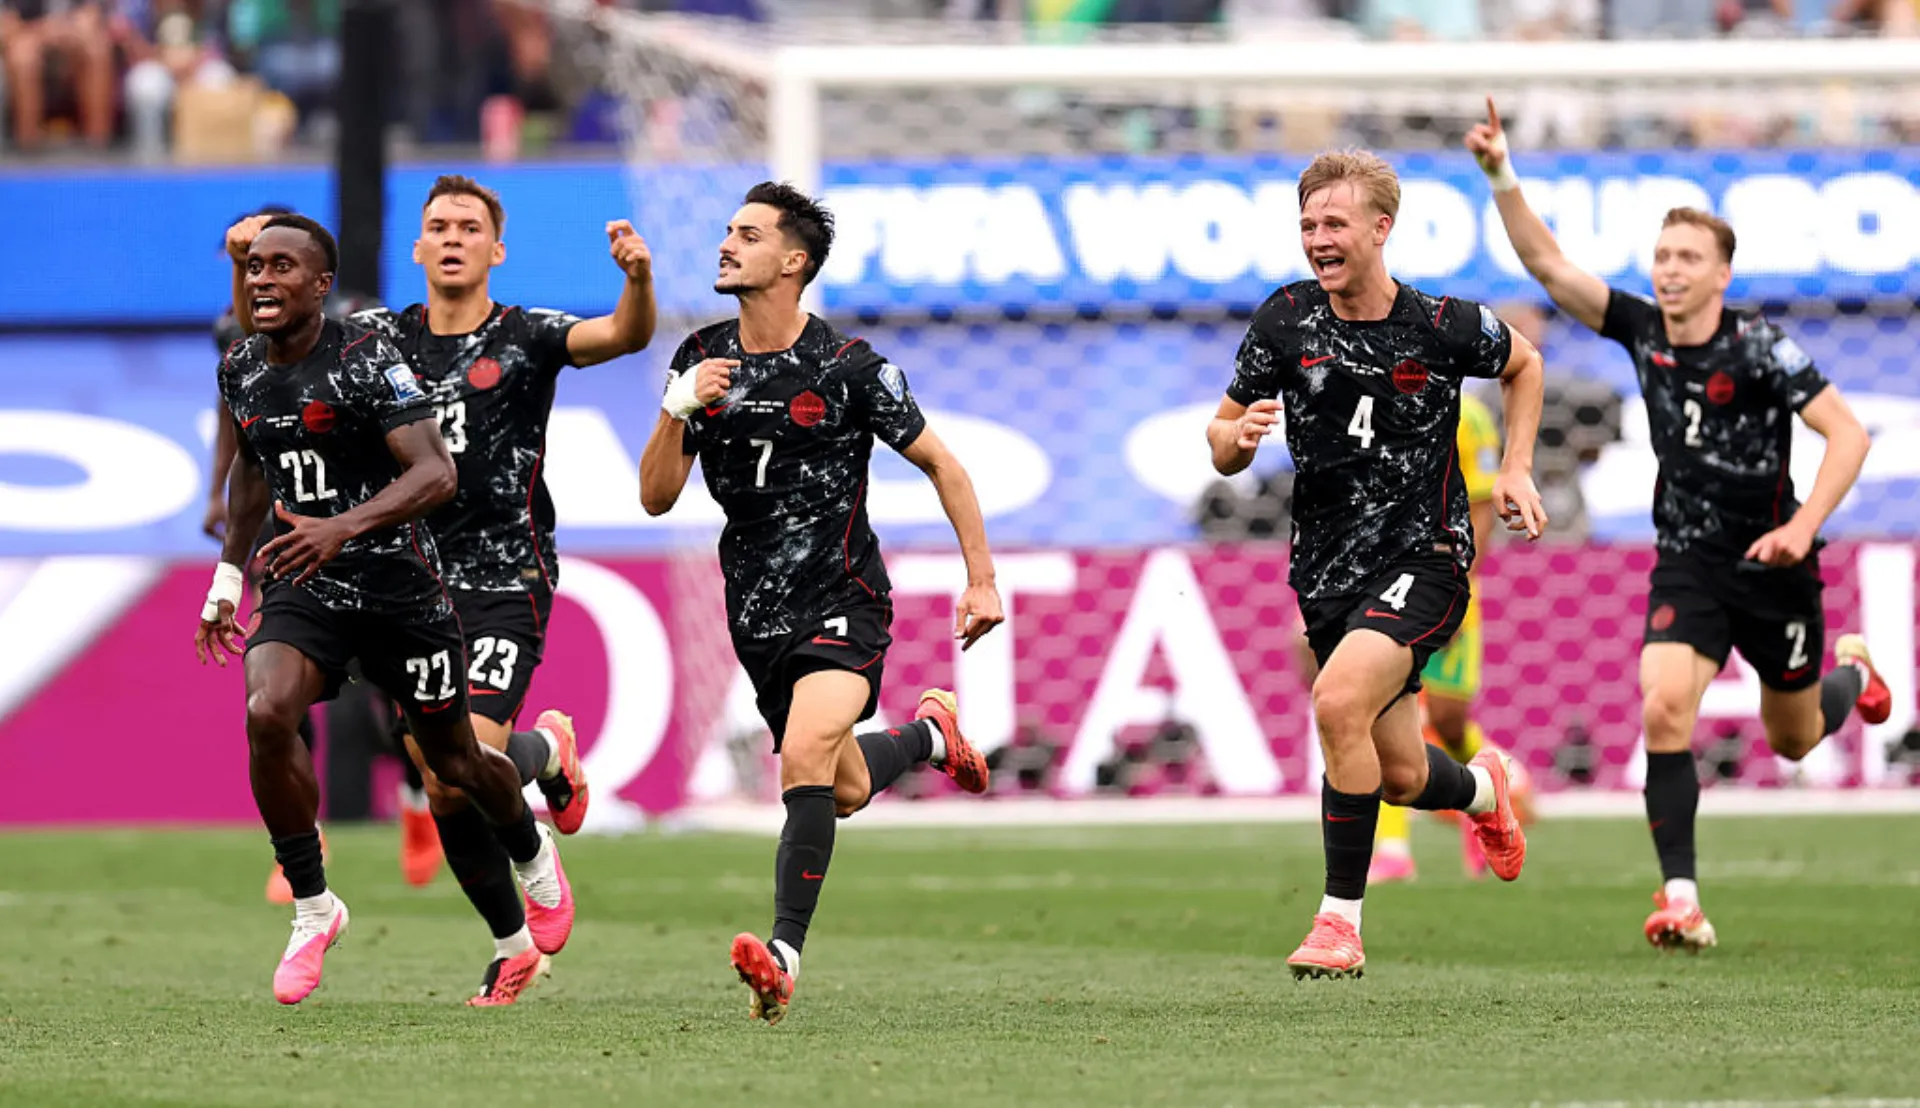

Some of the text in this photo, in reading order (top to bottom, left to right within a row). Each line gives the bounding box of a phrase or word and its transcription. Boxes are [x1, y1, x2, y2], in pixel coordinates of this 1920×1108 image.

[824, 183, 1067, 284] FIFA
[1067, 178, 1477, 284] WORD
[1347, 395, 1375, 449] 4
[1683, 399, 1702, 447] 2
[279, 449, 338, 503] 22
[750, 438, 773, 488] 7
[1379, 573, 1415, 612] 4
[468, 636, 519, 691] 23
[1785, 621, 1808, 670] 2
[406, 649, 457, 701] 22
[522, 545, 1325, 830] QTA
